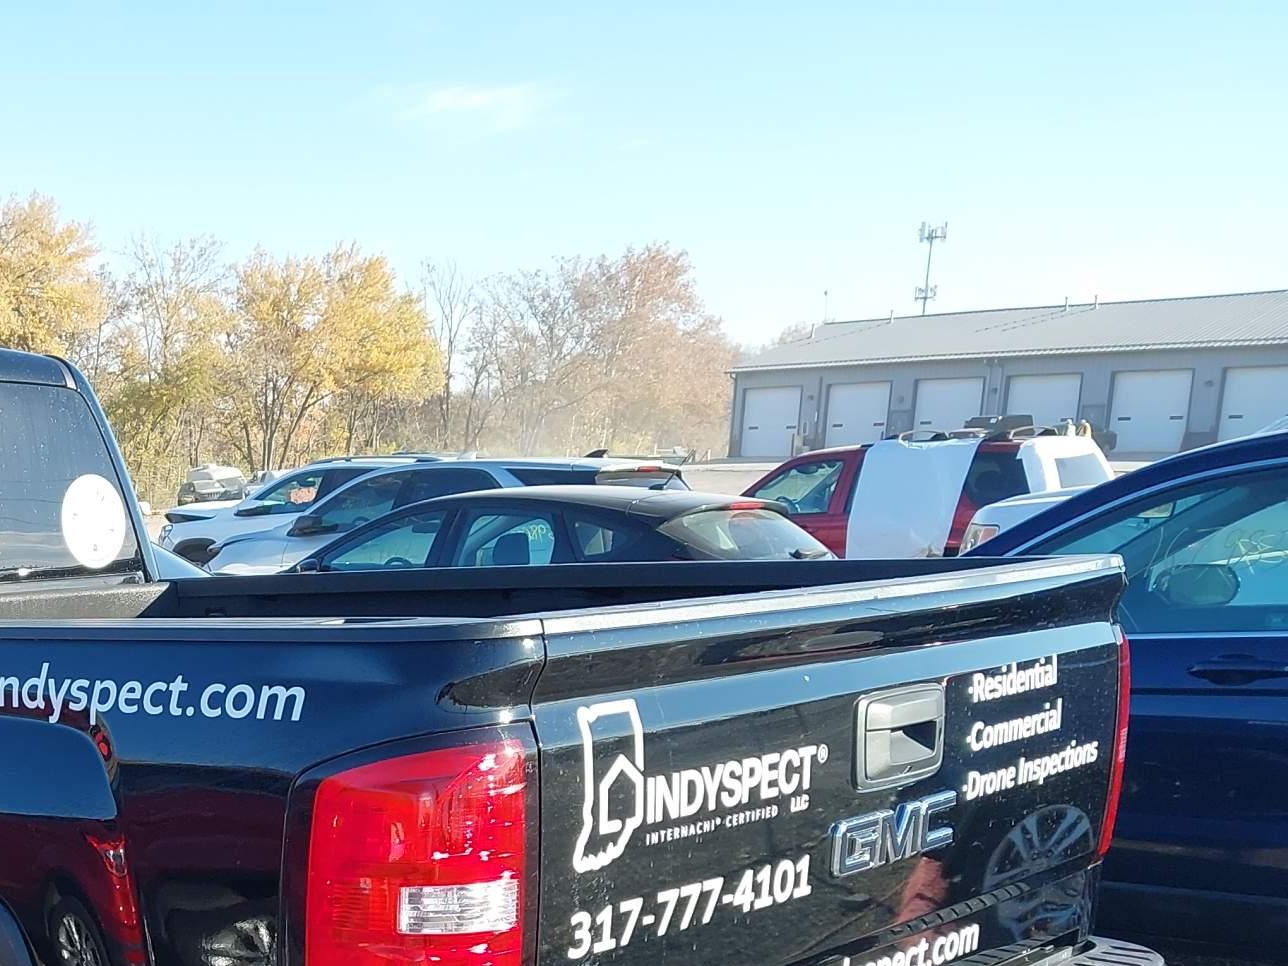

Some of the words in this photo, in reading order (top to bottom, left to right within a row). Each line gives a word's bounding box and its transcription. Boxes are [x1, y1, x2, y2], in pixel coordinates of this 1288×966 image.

[1018, 740, 1099, 784] Inspections
[725, 804, 779, 828] CERTIFIED
[790, 793, 810, 813] LLC
[829, 790, 958, 877] GMC
[567, 853, 812, 960] 317-777-4101
